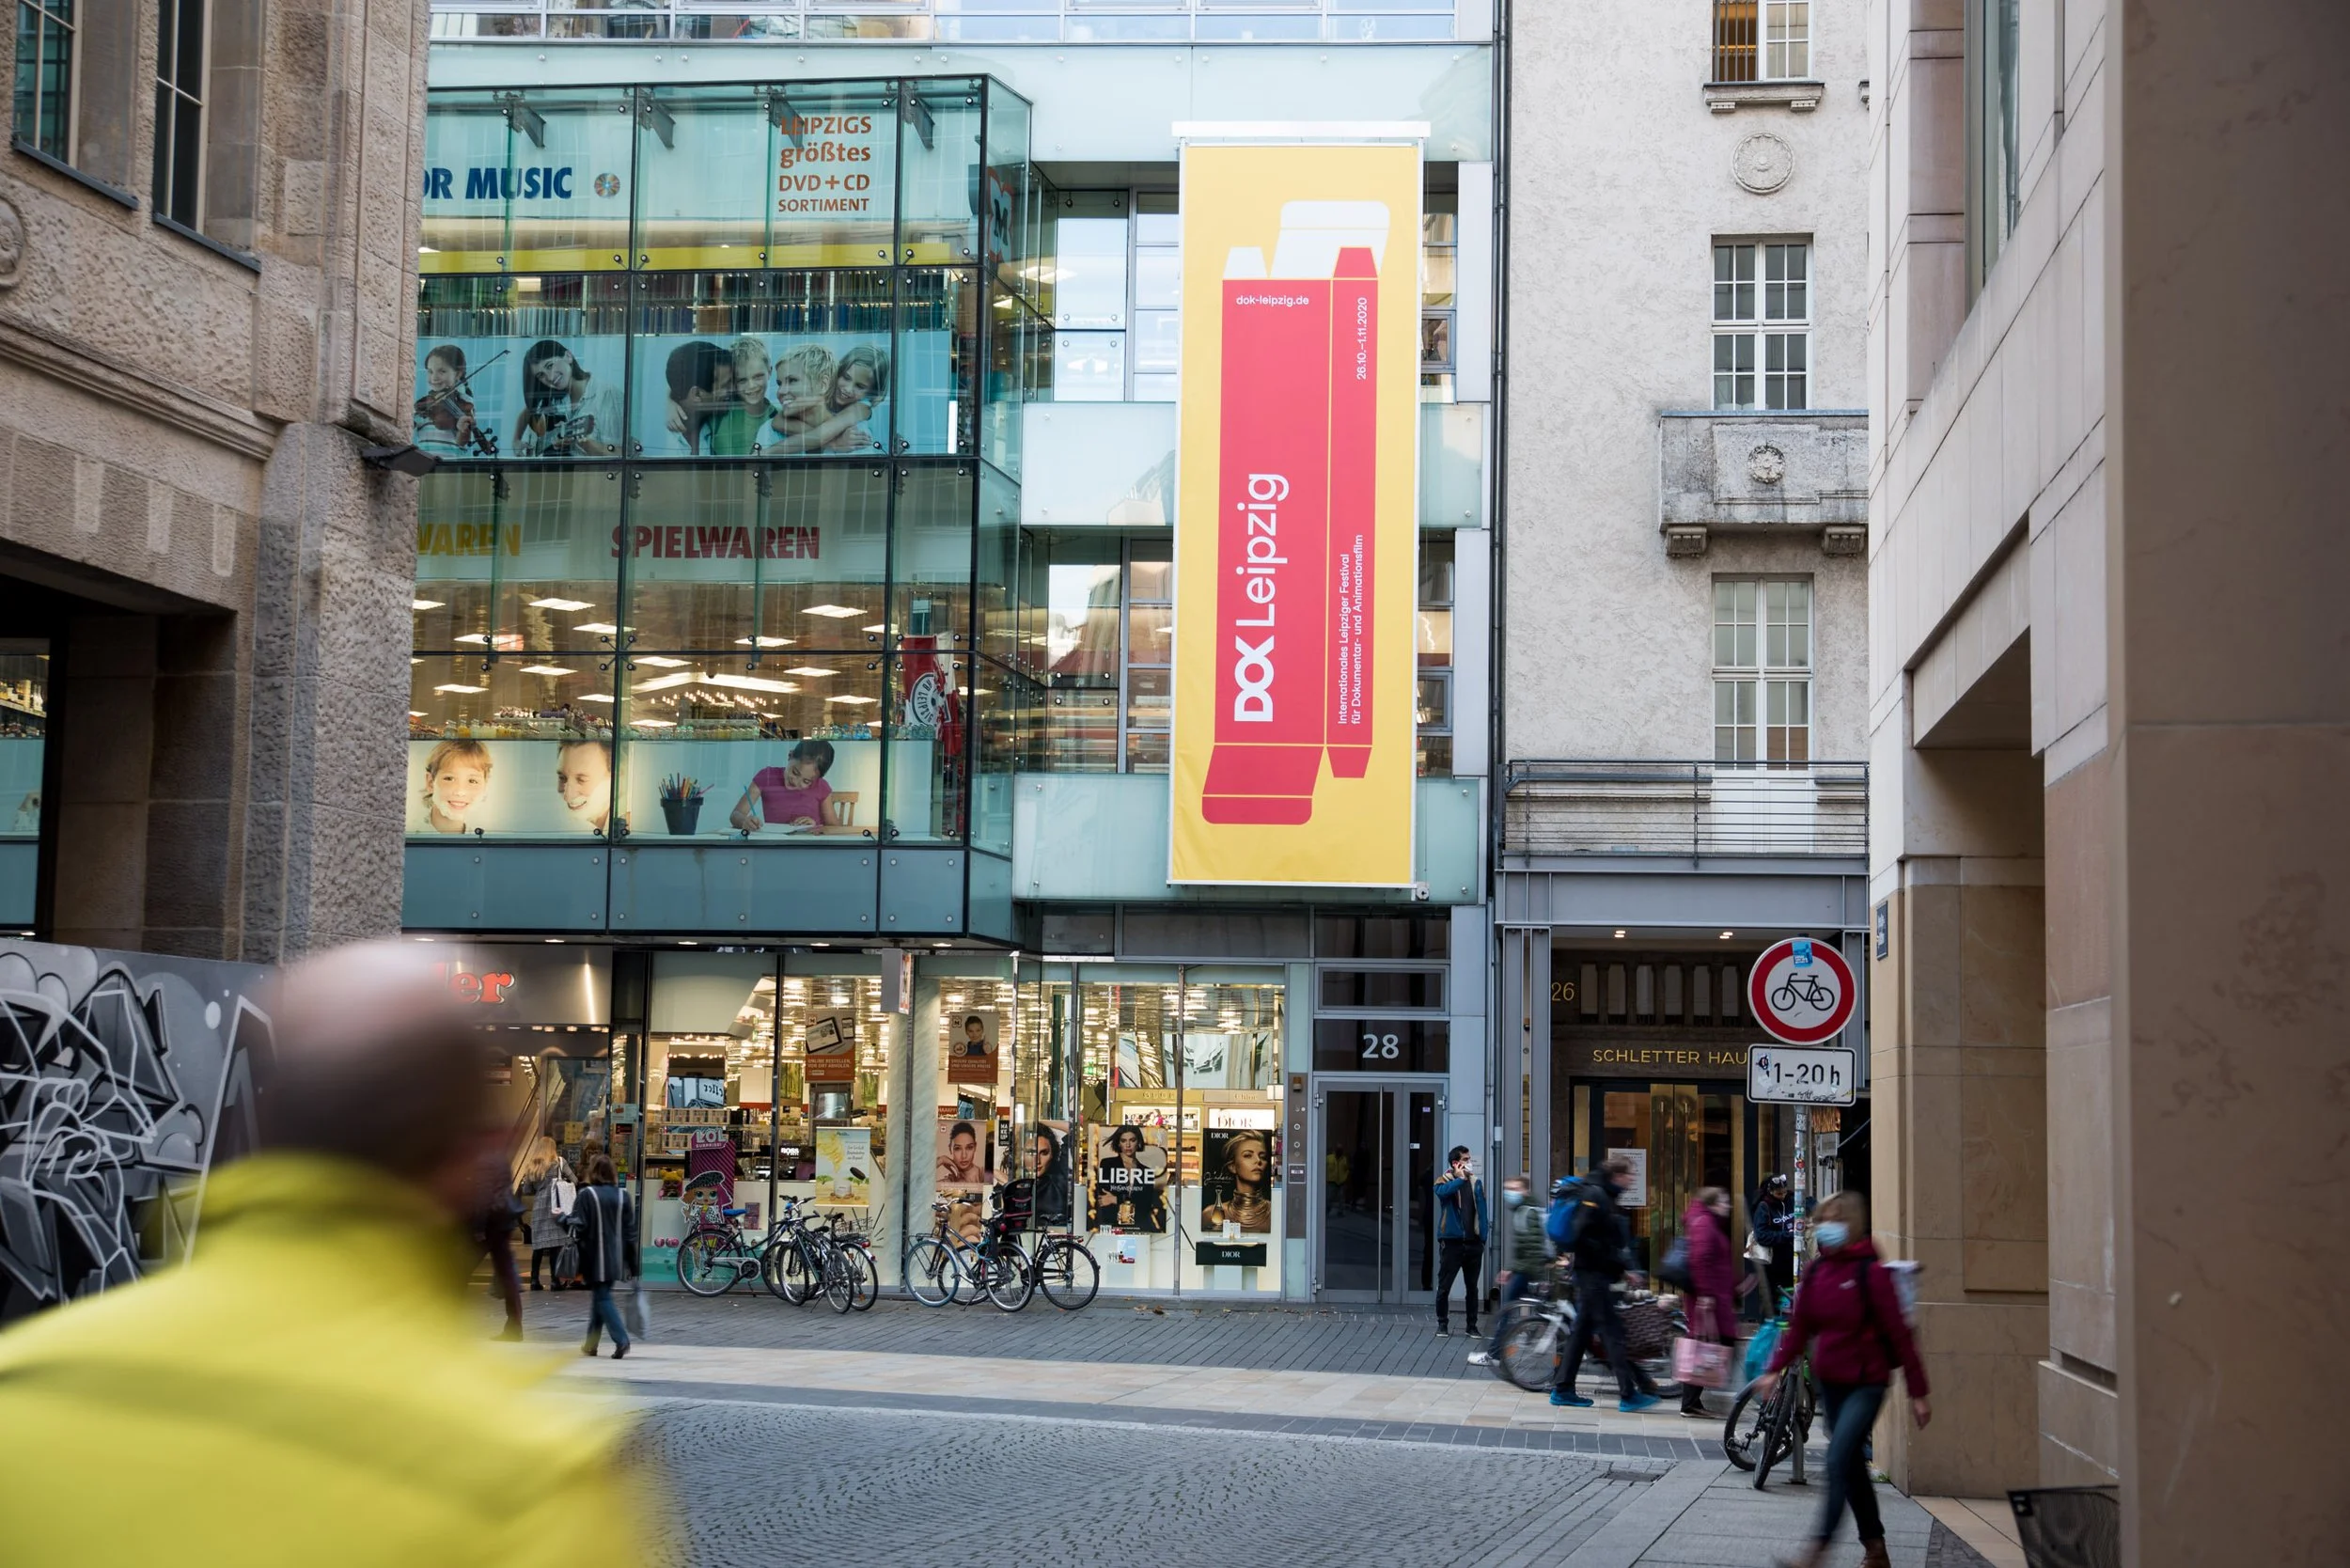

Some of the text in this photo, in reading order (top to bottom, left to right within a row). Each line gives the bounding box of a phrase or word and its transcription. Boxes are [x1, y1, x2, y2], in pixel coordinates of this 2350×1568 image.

[781, 116, 872, 135] LEIPZIGS
[779, 141, 871, 169] größtes
[465, 166, 573, 199] MUSIC
[778, 198, 870, 212] SORTIMENT
[1235, 294, 1309, 307] dok-leipzig.de
[611, 525, 821, 559] SPIELWAREN
[1233, 474, 1290, 722] DOK Leipzig
[1338, 553, 1352, 725] Internationales Leipziger Festival
[1351, 534, 1364, 725] für Dokumentar- und Animationsfilm
[1551, 982, 1575, 1002] 26
[1362, 1033, 1400, 1059] 28
[1592, 1048, 1748, 1065] SCHLETTER HAU
[1217, 1116, 1253, 1128] DIOR
[1098, 1168, 1156, 1184] LIBRE
